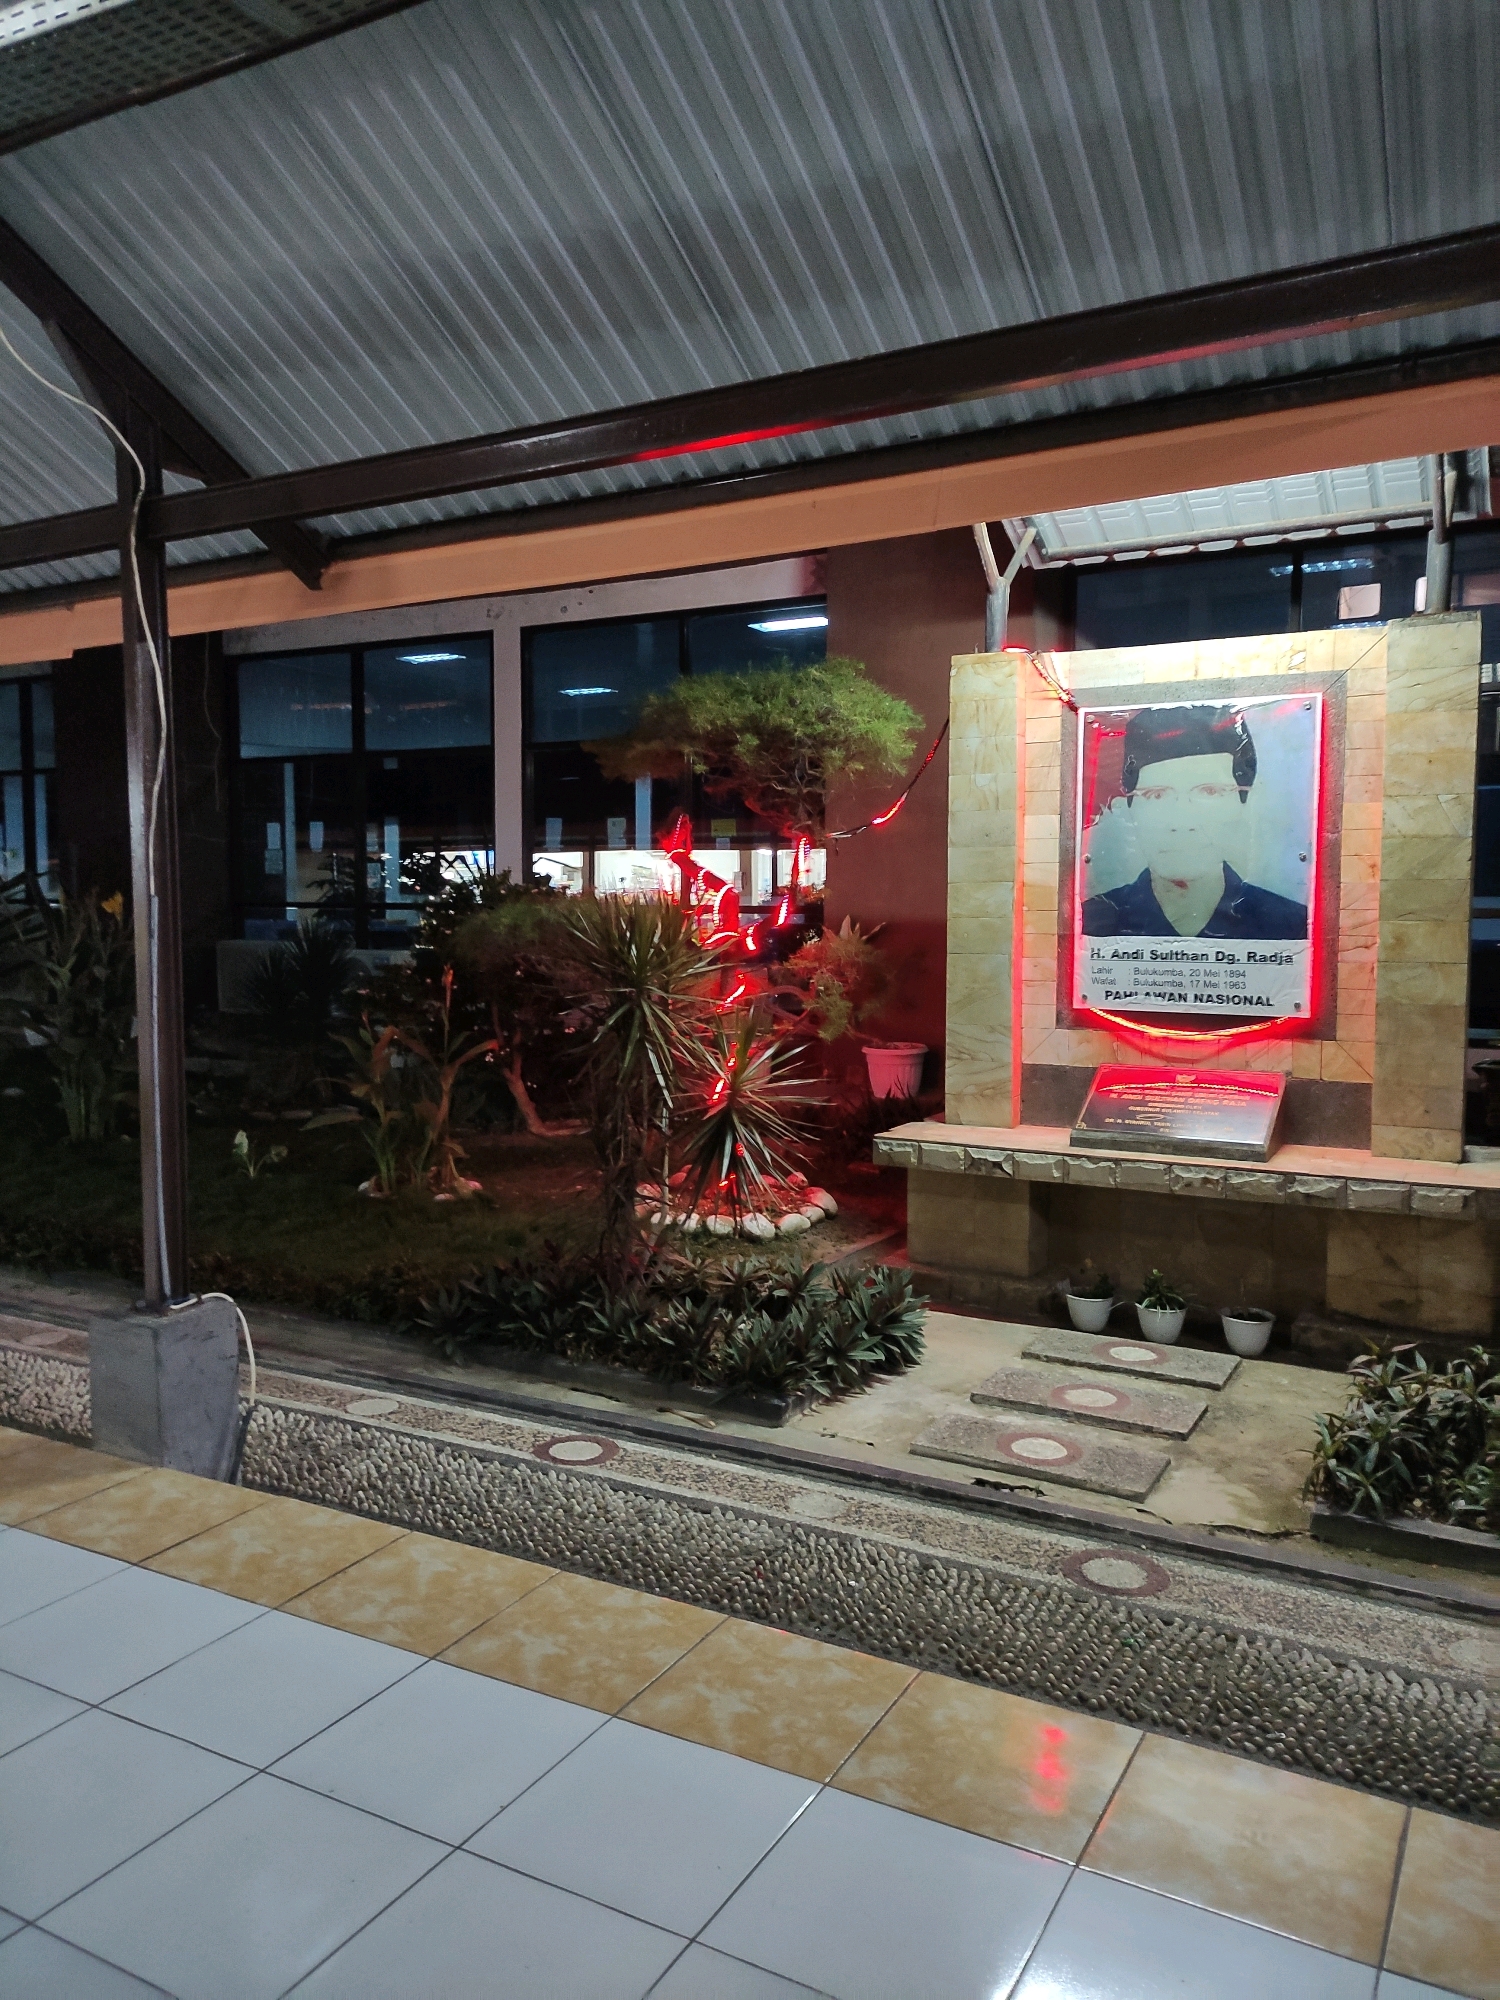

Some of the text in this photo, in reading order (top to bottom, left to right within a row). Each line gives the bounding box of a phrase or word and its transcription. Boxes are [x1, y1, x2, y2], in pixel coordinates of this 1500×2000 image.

[1090, 948, 1294, 965] H. Andi Sulthan Dg. Radja
[1091, 966, 1114, 975] Lahir
[1133, 966, 1186, 978] Bulukumba,
[1189, 969, 1201, 977] 20
[1203, 969, 1220, 978] Mei
[1224, 970, 1246, 978] 1894
[1091, 977, 1116, 986] Wafat
[1133, 978, 1186, 988] Bulukumba,
[1190, 980, 1200, 988] 17
[1203, 980, 1220, 989] Mei
[1224, 981, 1247, 989] 1963
[1193, 993, 1275, 1007] NASIONAL
[1222, 1099, 1247, 1107] RAJA
